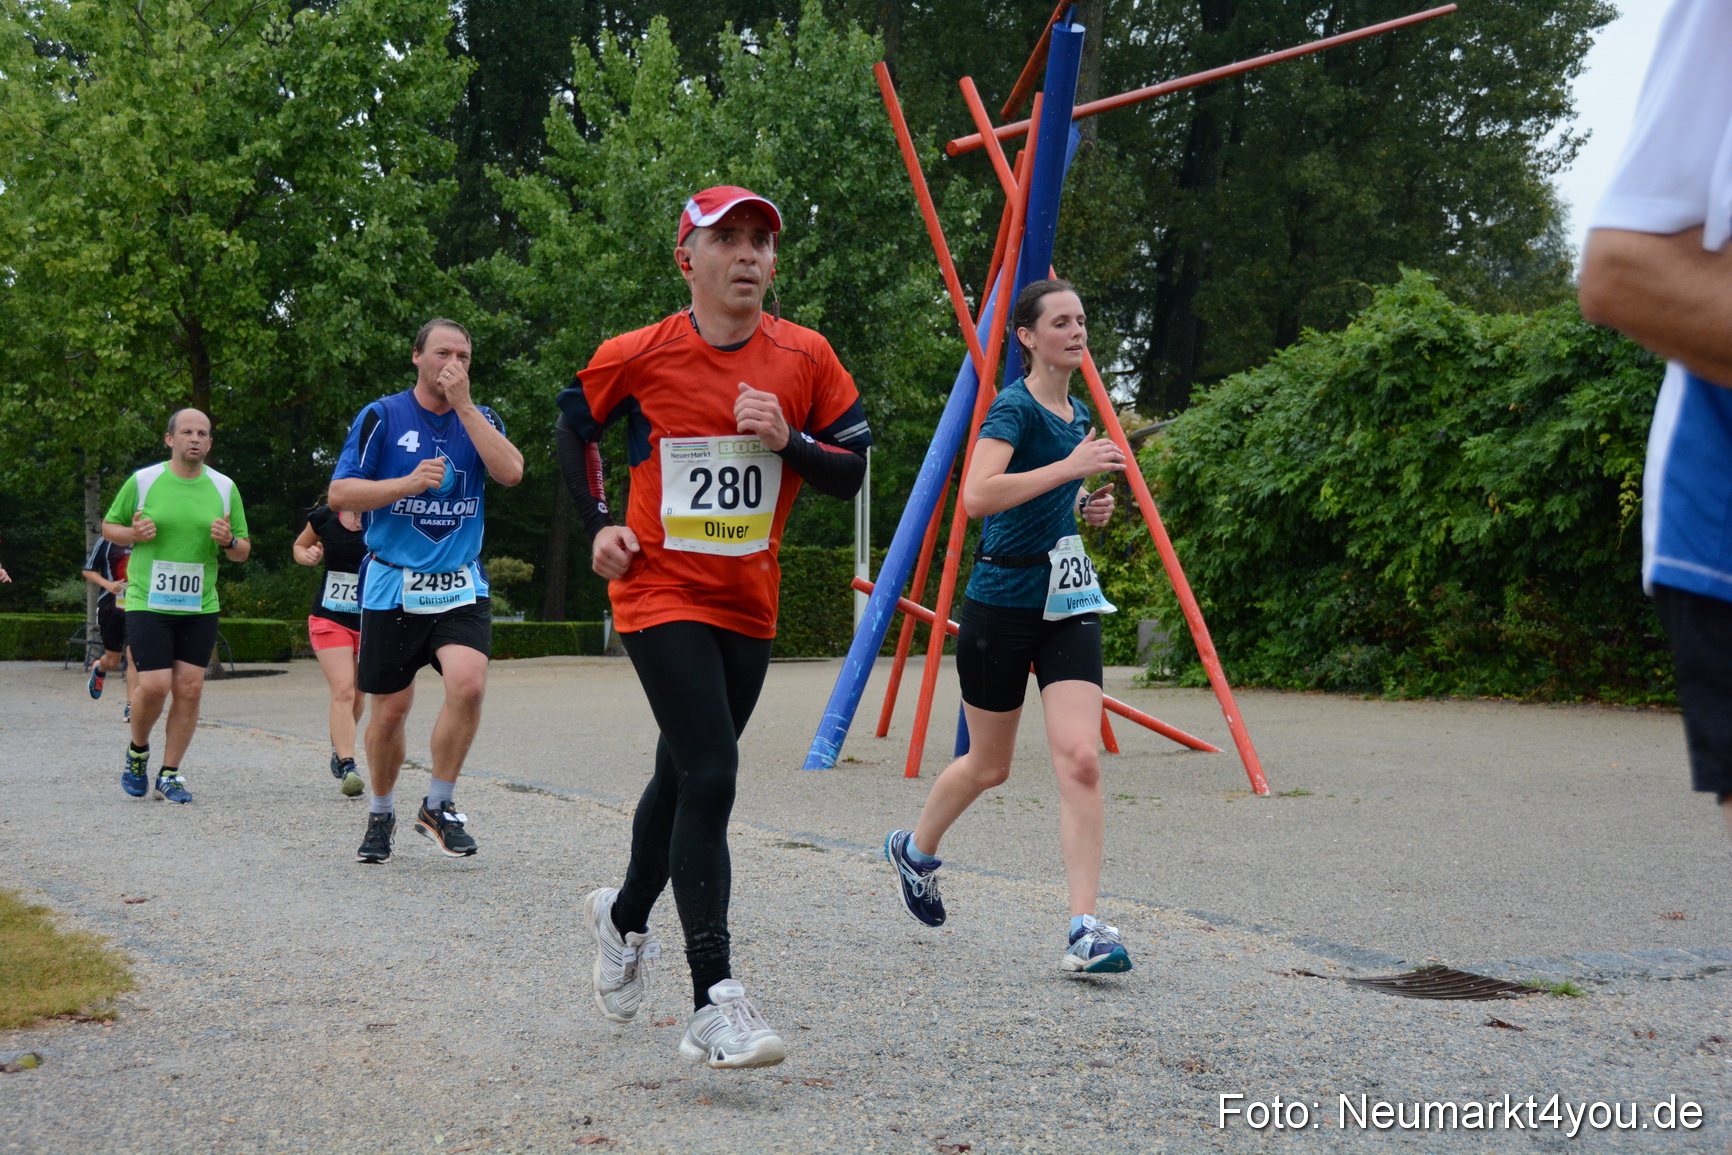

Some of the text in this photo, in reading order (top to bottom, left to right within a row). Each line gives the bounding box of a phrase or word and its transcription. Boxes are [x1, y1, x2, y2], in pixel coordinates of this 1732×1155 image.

[397, 430, 420, 452] 4
[671, 451, 711, 459] NeuerMarkt
[689, 465, 762, 510] 280
[420, 518, 456, 527] BASKETS
[704, 521, 749, 539] Oliver
[156, 573, 200, 593] 3100
[410, 570, 467, 592] 2495
[419, 594, 460, 605] Christian
